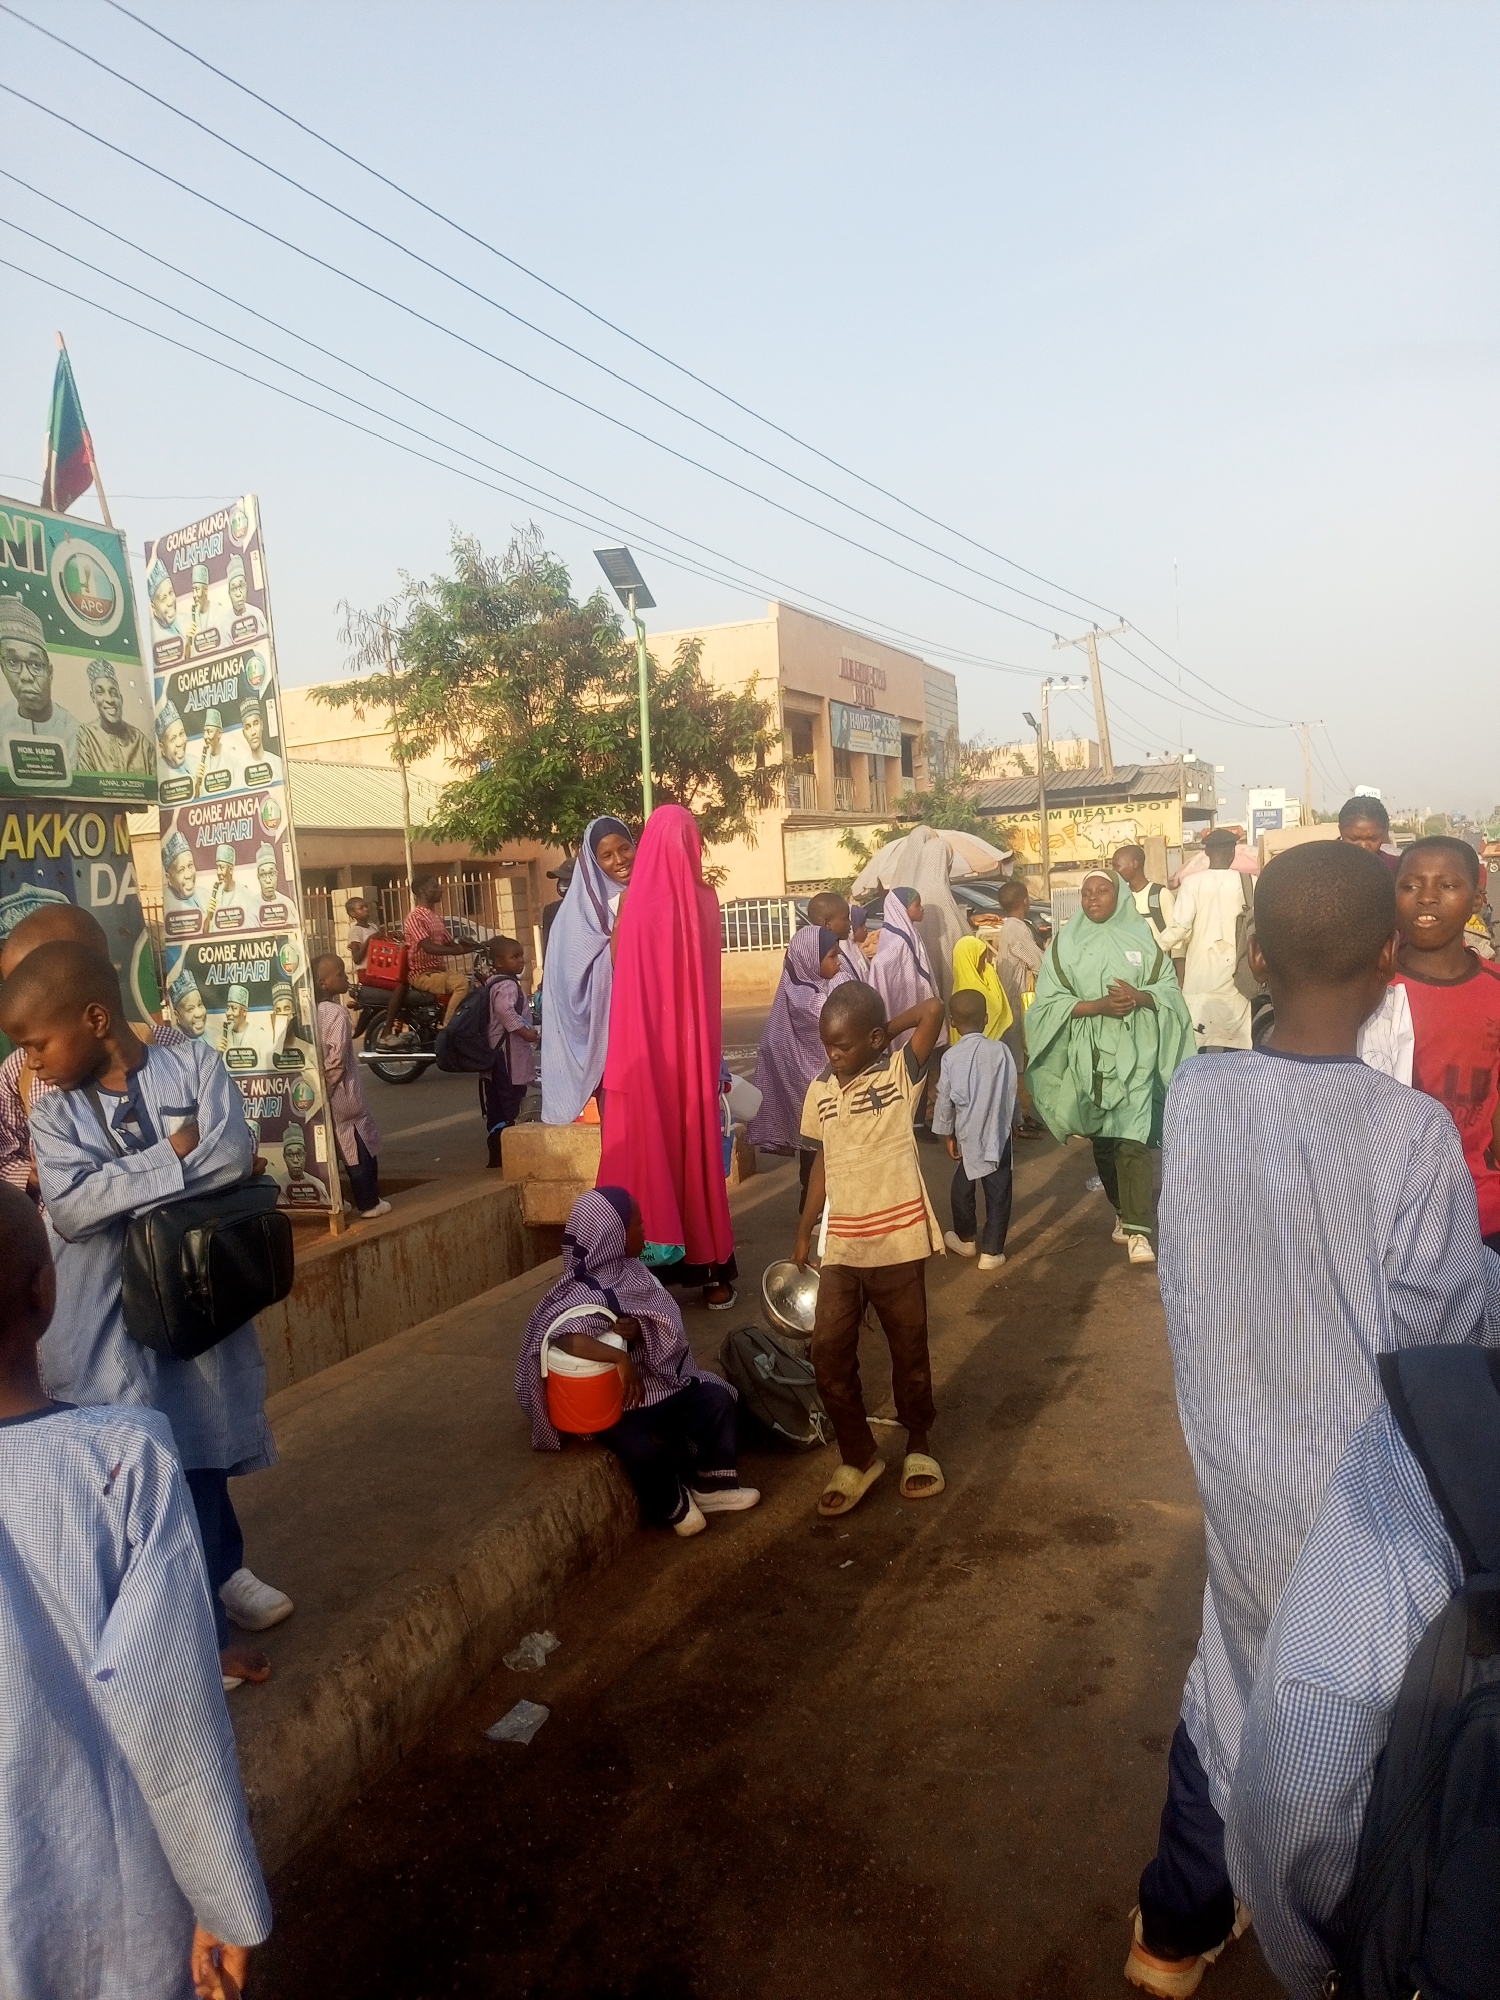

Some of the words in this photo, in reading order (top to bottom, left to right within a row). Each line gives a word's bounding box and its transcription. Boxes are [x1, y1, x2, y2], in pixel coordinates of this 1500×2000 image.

[166, 523, 198, 552] GOMBE
[198, 510, 230, 540] MUNGA
[173, 531, 223, 574] ALKHAIRI
[80, 599, 104, 614] APC
[178, 667, 209, 692] GOMBE
[211, 656, 245, 682] MUNGA
[184, 677, 238, 713] ALKHAIRI
[188, 804, 222, 826] GOMBE
[224, 797, 260, 820] MUNGA
[1069, 806, 1116, 818] MEAT
[1123, 800, 1172, 813] SPOT
[0, 812, 107, 860] AKKO
[196, 817, 253, 848] ALKHAIRI
[198, 944, 237, 964] GOMBE
[239, 941, 278, 961] MUNGA
[205, 960, 271, 985] ALKHAIRI
[251, 1077, 291, 1096] MUNGA
[243, 1096, 283, 1118] HAIRI
